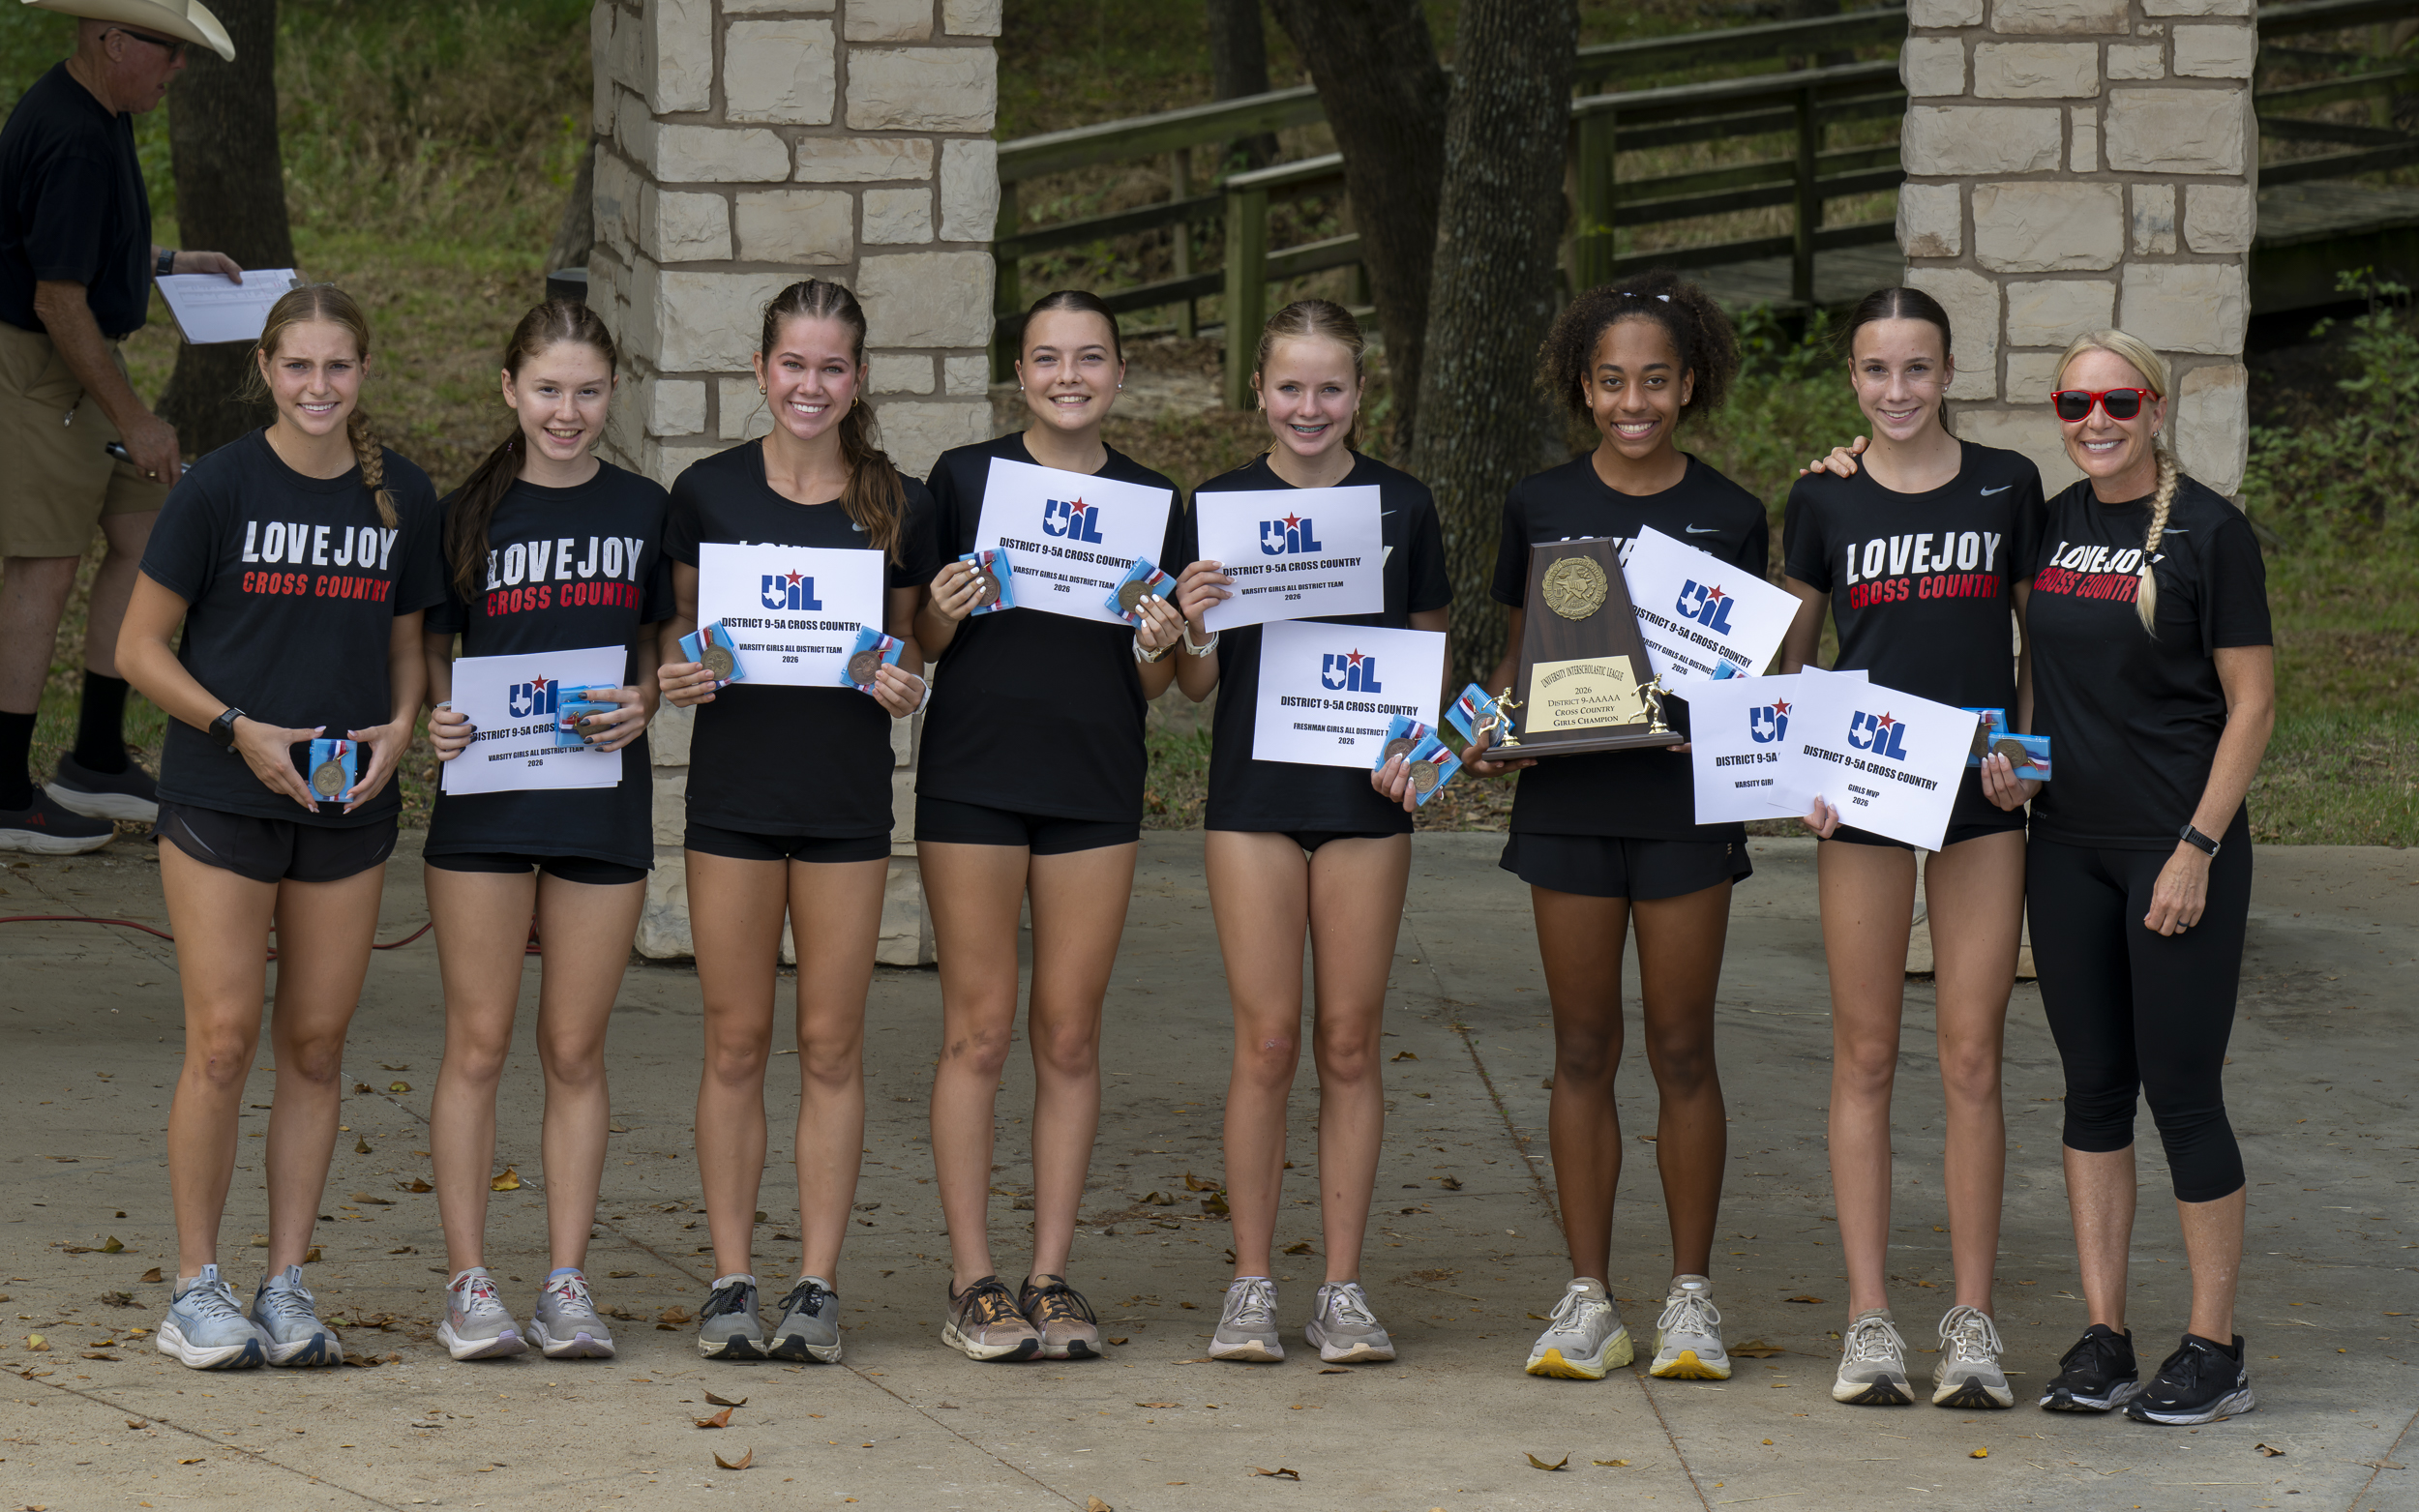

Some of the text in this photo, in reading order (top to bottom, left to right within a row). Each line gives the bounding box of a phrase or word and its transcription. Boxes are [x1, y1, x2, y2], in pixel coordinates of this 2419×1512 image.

[242, 521, 399, 570] LOVEJOY
[1000, 537, 1041, 553] DISTRICT
[1041, 545, 1062, 558] 9-5A
[1064, 548, 1093, 563] CROSS
[486, 536, 644, 590] LOVEJOY
[1223, 557, 1360, 577] DISTRICT 9-5A CROSS COUNTRY
[1846, 532, 2001, 586] LOVEJOY
[243, 572, 391, 602] CROSS COUNTRY
[1014, 565, 1115, 590] VARSITY GIRLS ALL DISTRICT TEAM
[2034, 567, 2082, 595] CROSS
[1054, 583, 1070, 593] 2026
[1850, 575, 2000, 609] CROSS COUNTRY
[488, 582, 640, 617] CROSS COUNTRY
[722, 617, 861, 632] DISTRICT 9-5A CROSS COUNTRY
[739, 643, 765, 652] VARSITY
[796, 644, 824, 654] DISTRICT
[1669, 622, 1689, 639] 9-5A
[1690, 633, 1718, 652] CROSS
[1718, 645, 1752, 667] COUNTRY
[1643, 637, 1716, 675] RSITY GIRLS ALL DISTRICT
[1540, 665, 1624, 688] UNIVERSITY INTERSCHOLASTIC LEAGUE
[1672, 664, 1687, 675] 2026
[1281, 697, 1419, 716] DISTRICT 9-5A CROSS COUNTRY
[1581, 695, 1620, 704] 9-AAAAA
[512, 726, 530, 737] 9-5A
[532, 723, 555, 734] CROS
[1293, 723, 1326, 732] FRESHMAN
[1327, 725, 1344, 733] GIRLS
[1357, 727, 1385, 736] DISTRICT
[1749, 697, 1792, 743] UI
[488, 753, 513, 761] VARSITY
[540, 747, 567, 756] DISTRICT
[528, 758, 544, 767] 2026
[1716, 753, 1777, 766] DISTRICT 9-5A
[1804, 745, 1937, 791] DISTRICT 9-5A CROSS COUNTRY
[1735, 780, 1759, 788] VARSITY
[1848, 784, 1879, 799] GIRLS MVP
[1852, 796, 1869, 807] 2026
